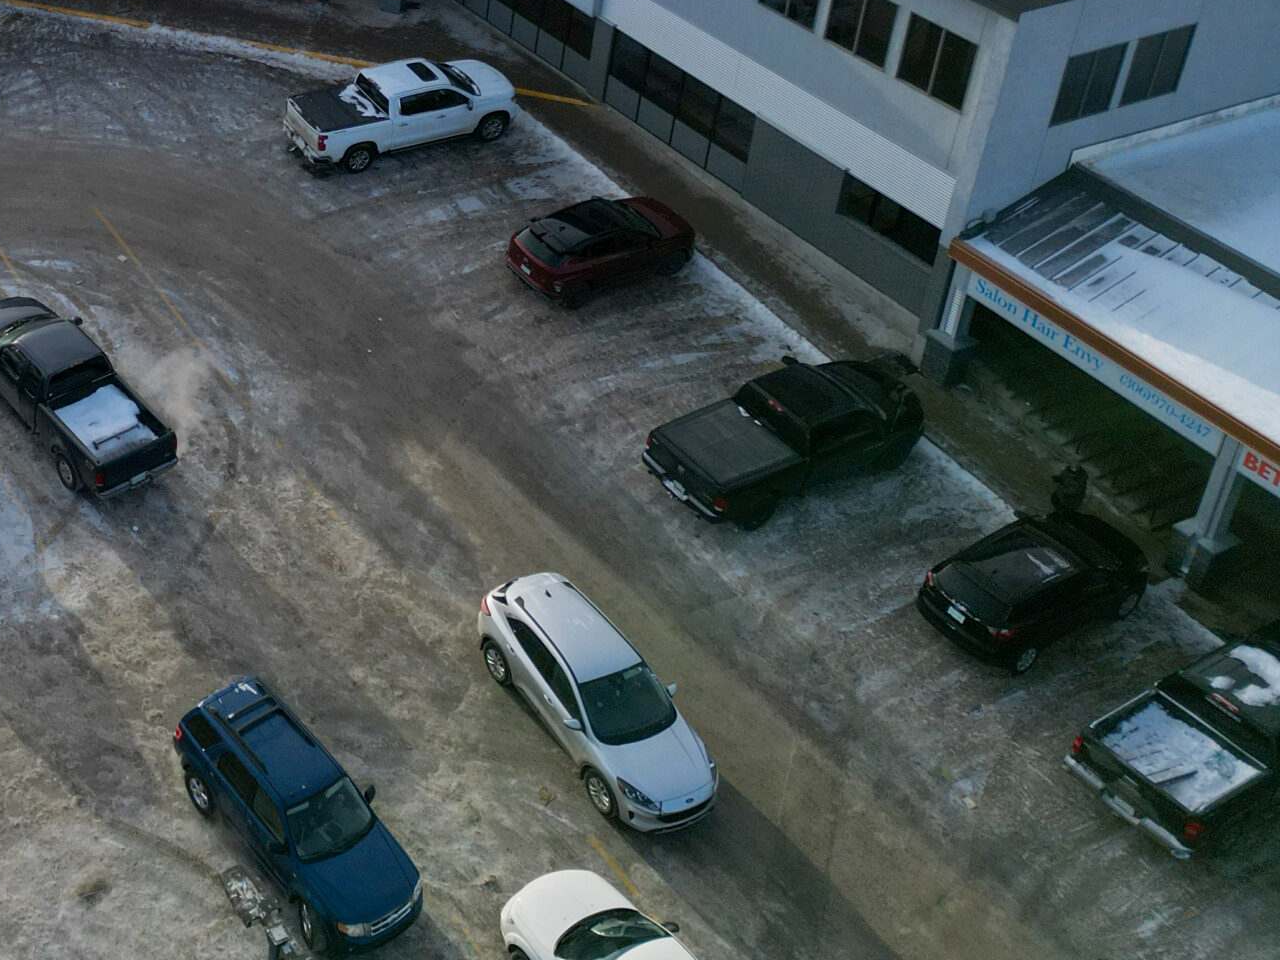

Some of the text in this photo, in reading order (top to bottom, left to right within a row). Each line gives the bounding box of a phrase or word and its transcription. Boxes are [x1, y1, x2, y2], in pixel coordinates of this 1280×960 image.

[975, 279, 1017, 315] Salon
[1021, 307, 1059, 341] Hair
[1062, 334, 1105, 371] Envy
